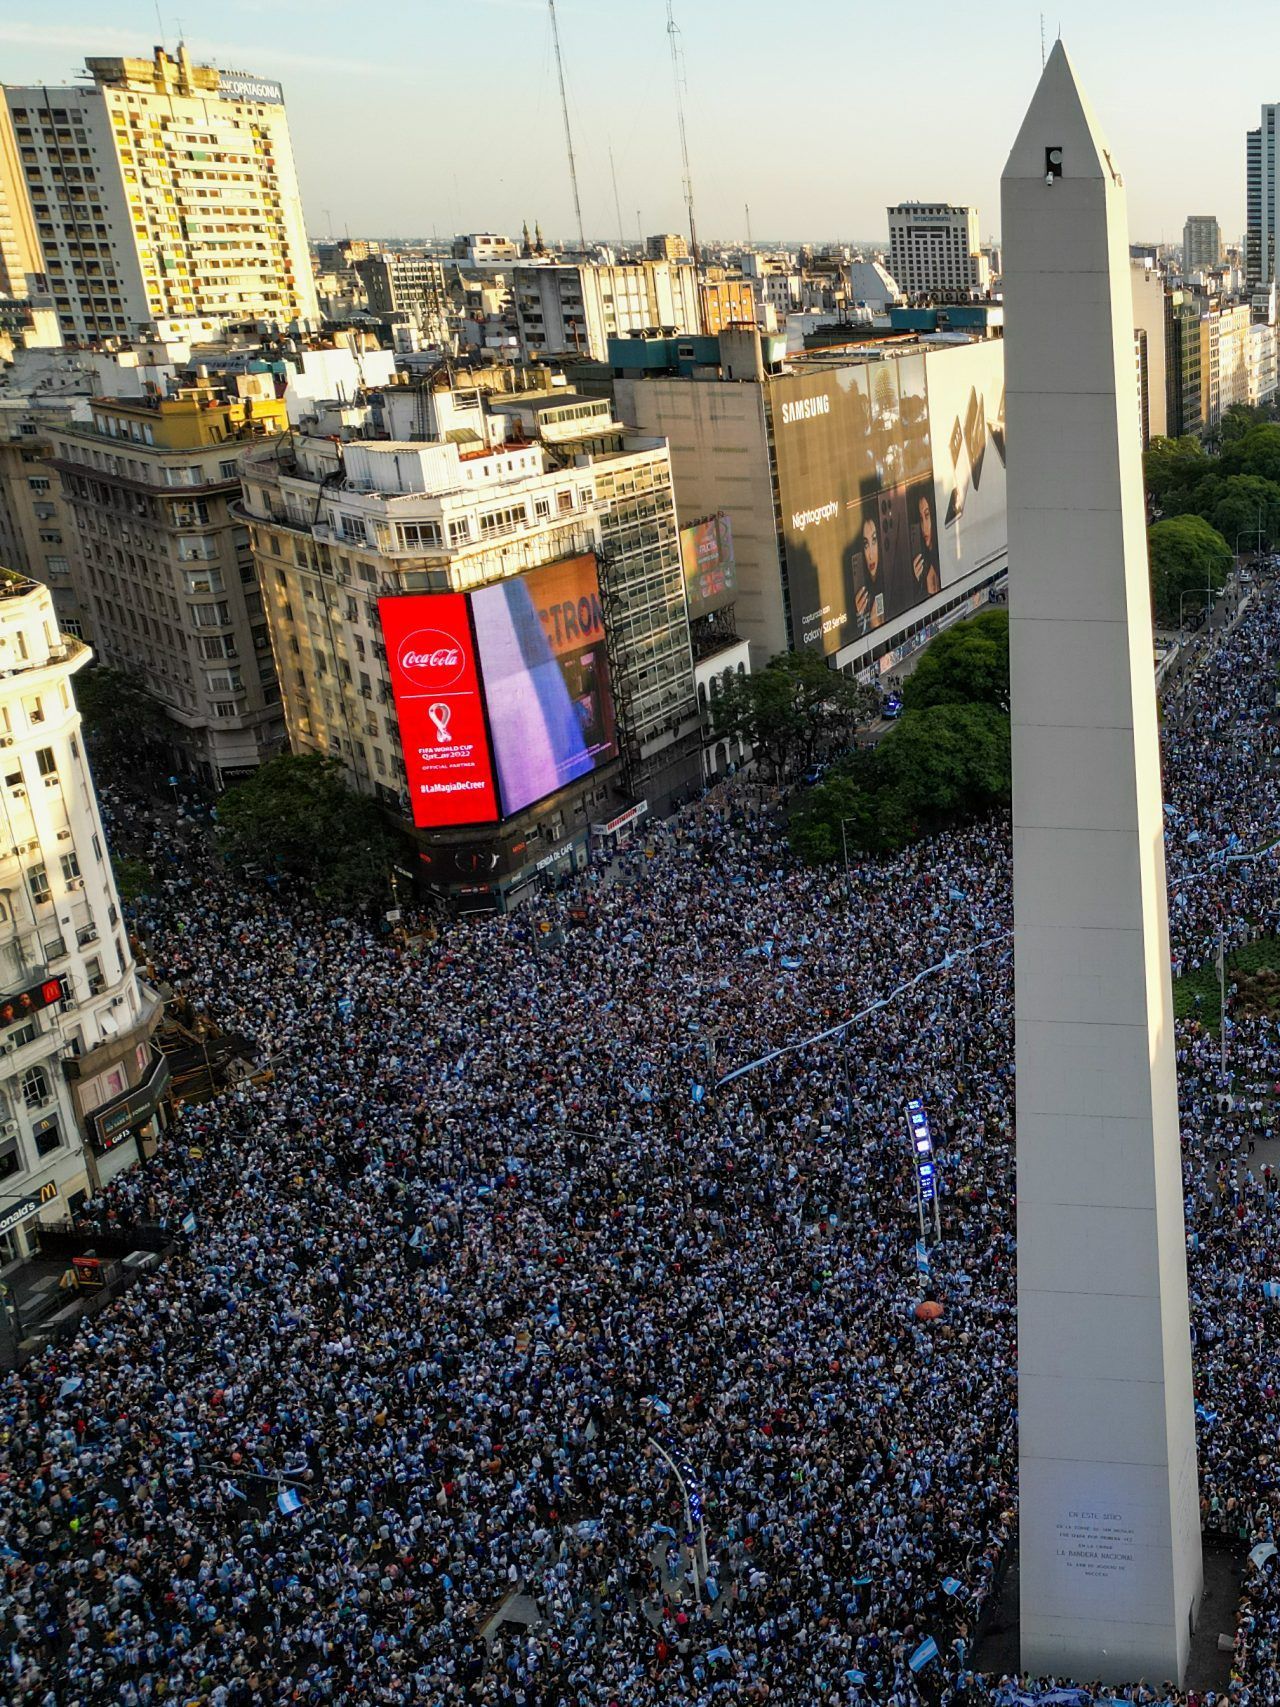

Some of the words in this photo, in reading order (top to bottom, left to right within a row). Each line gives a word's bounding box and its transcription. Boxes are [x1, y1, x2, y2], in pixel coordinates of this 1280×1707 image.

[782, 394, 829, 423] SAMSUNG
[792, 500, 838, 531] Nightography
[803, 625, 823, 644] Galaxy
[822, 617, 833, 634] S22
[832, 611, 848, 629] Series
[402, 648, 459, 668] Coca-Cola
[420, 781, 485, 793] #LaMagiaDeCreer
[536, 854, 553, 871] TIENDA
[1068, 1550, 1098, 1558] BANDERA
[1101, 1552, 1135, 1561] NACIONAL
